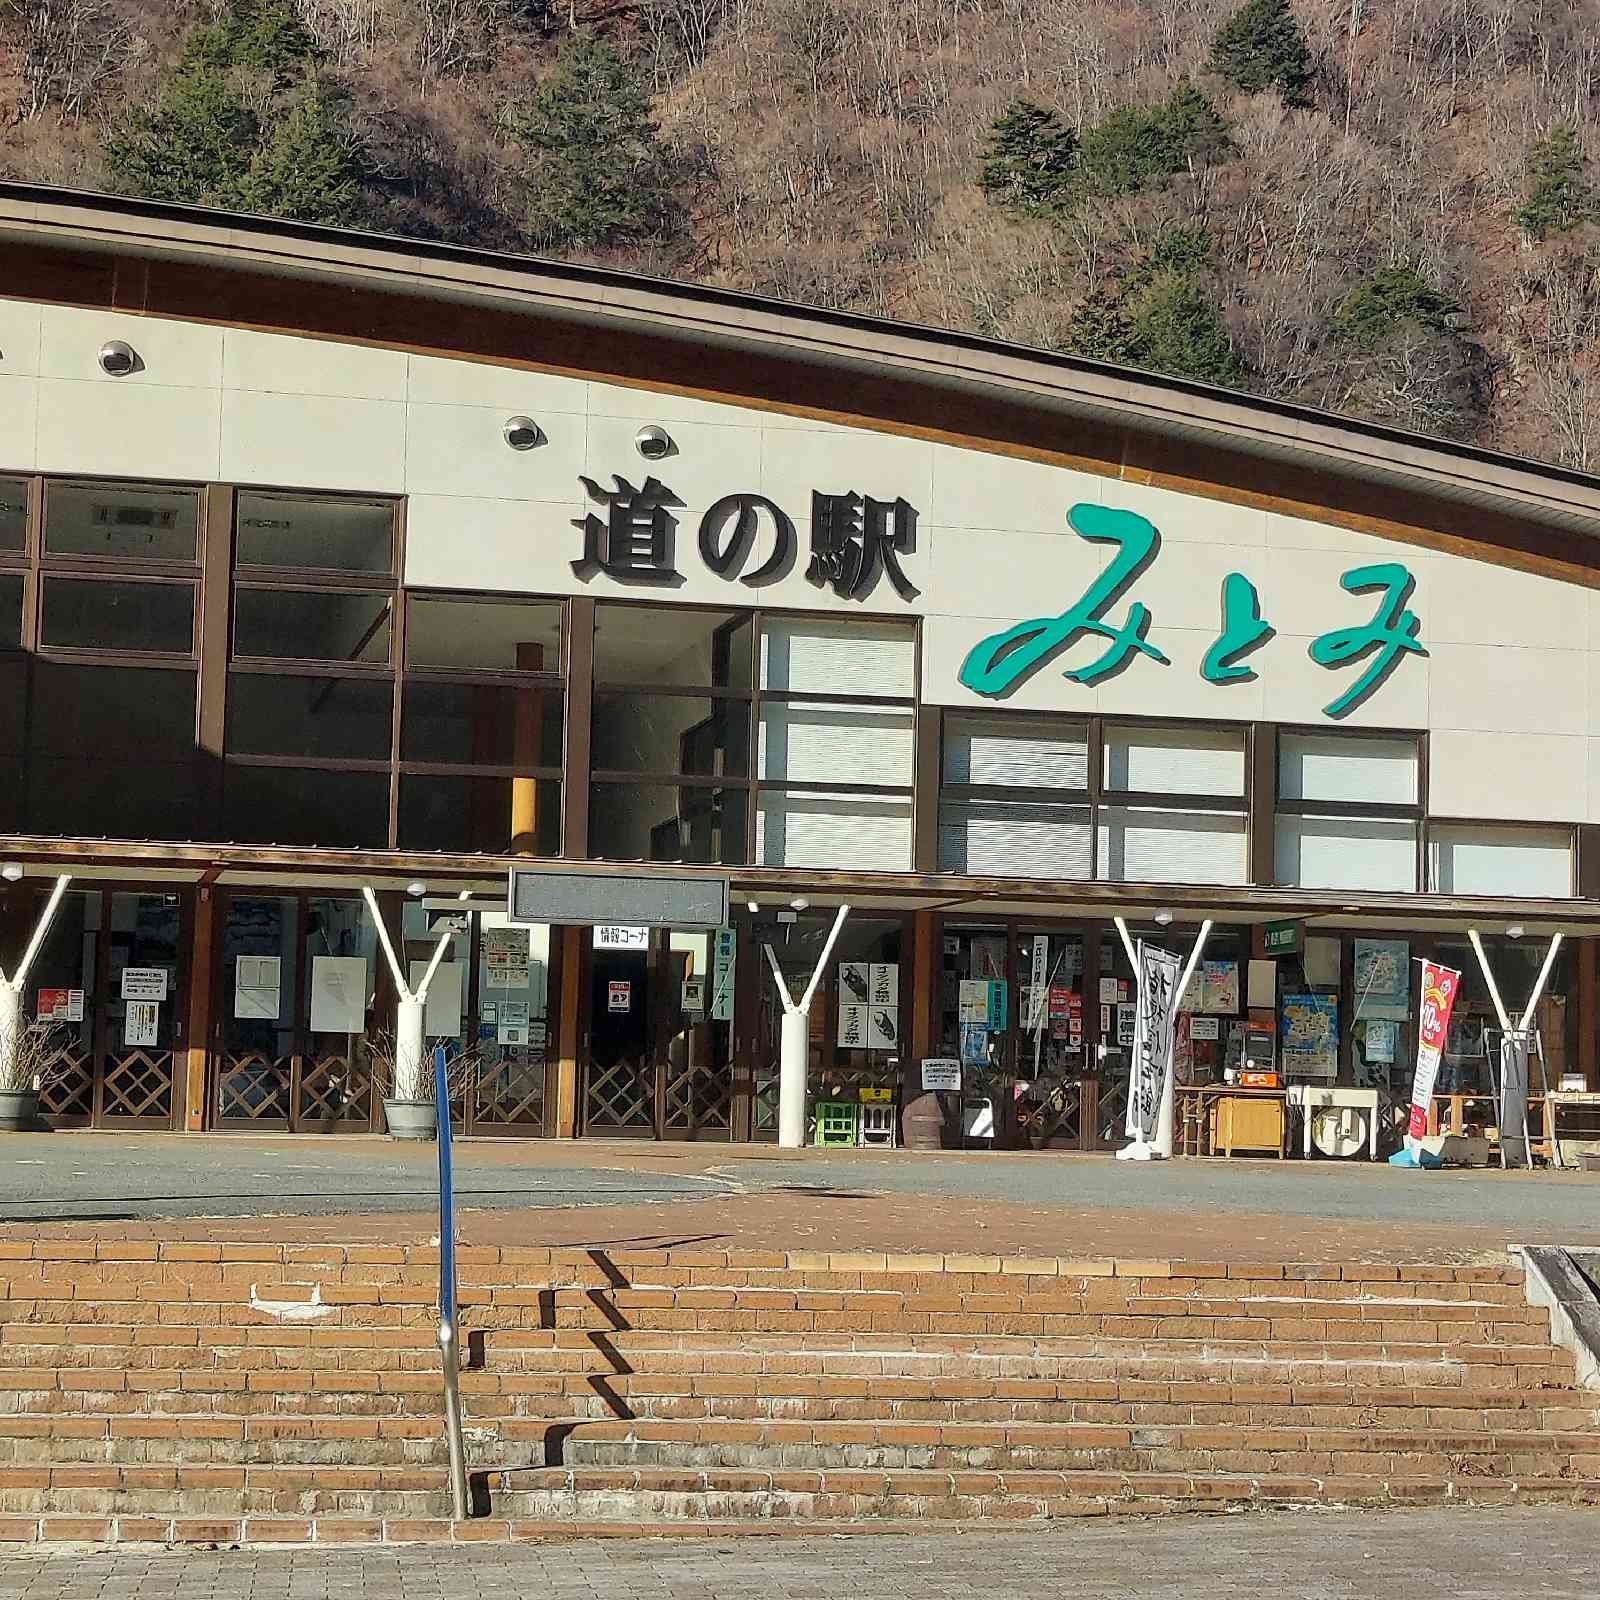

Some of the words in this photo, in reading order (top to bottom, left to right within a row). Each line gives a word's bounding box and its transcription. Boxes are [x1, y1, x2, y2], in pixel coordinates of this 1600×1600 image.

[570, 474, 921, 603] 道の駅
[958, 503, 1428, 719] みとみ
